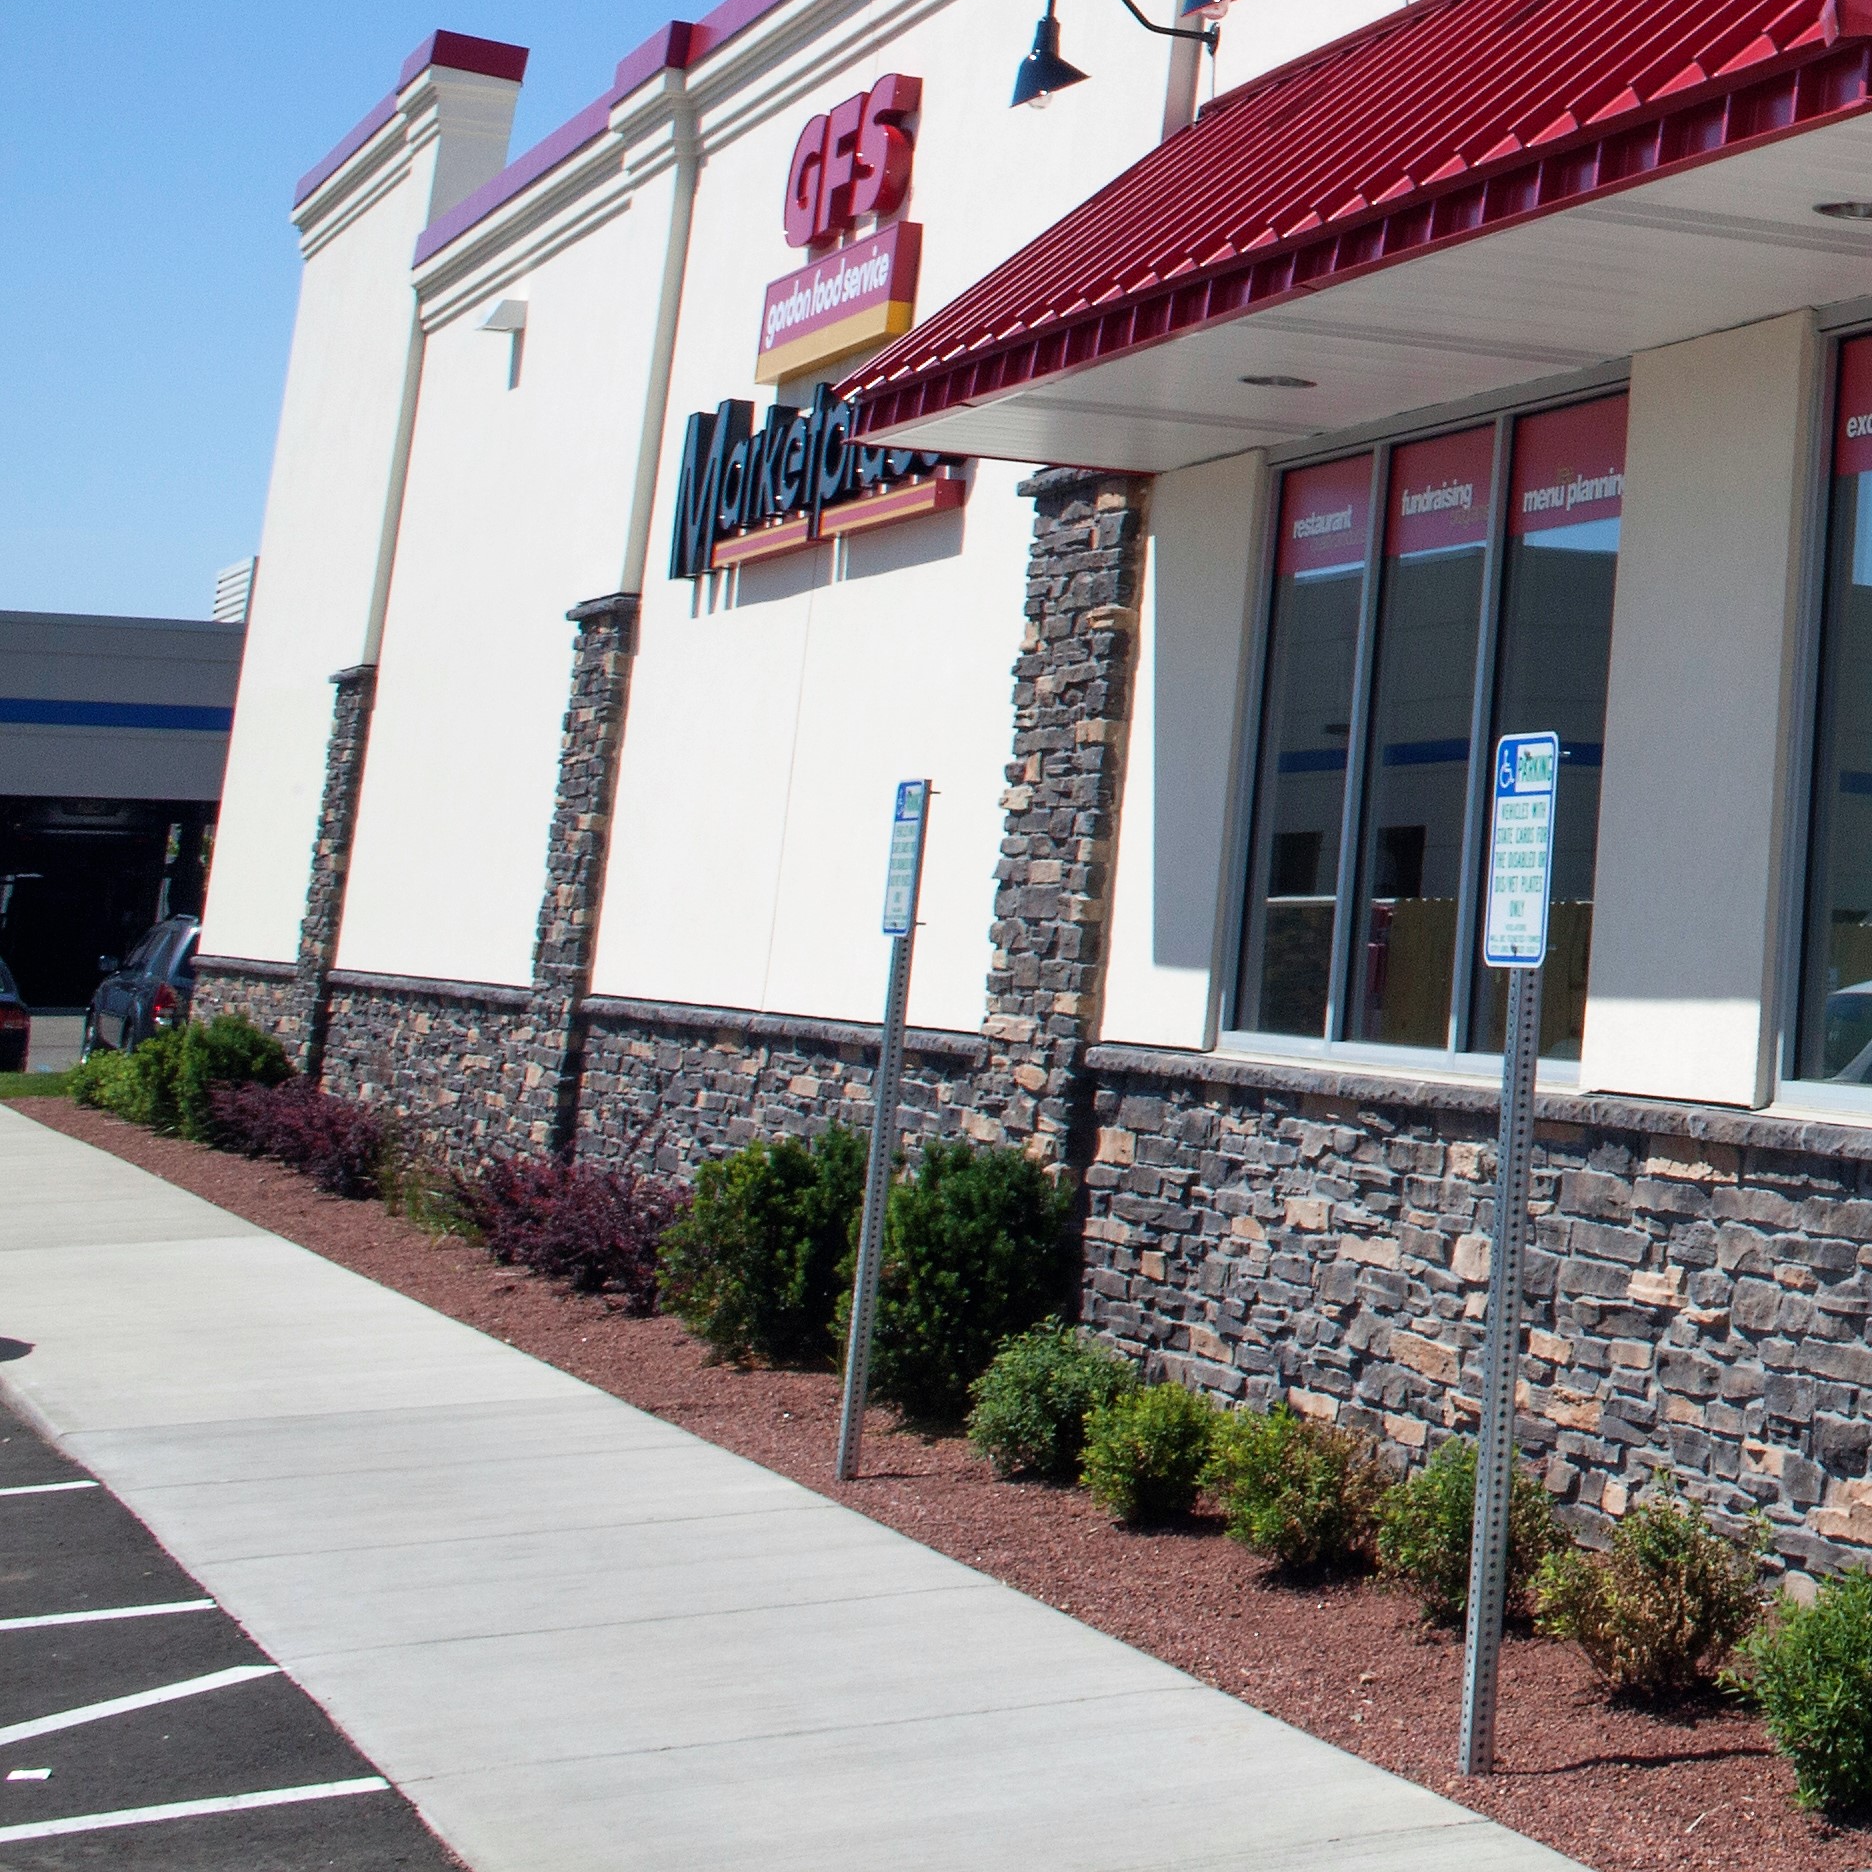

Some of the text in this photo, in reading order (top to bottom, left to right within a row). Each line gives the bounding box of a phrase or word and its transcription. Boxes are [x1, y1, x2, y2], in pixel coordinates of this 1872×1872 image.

[784, 73, 923, 248] GFS
[765, 245, 889, 349] gordon food service
[670, 381, 965, 580] Marketpl
[1401, 479, 1473, 516] fundraising
[1523, 486, 1564, 513] menu
[1567, 467, 1624, 512] plannin
[1292, 504, 1352, 540] restaurant
[1518, 754, 1552, 782] PARKING
